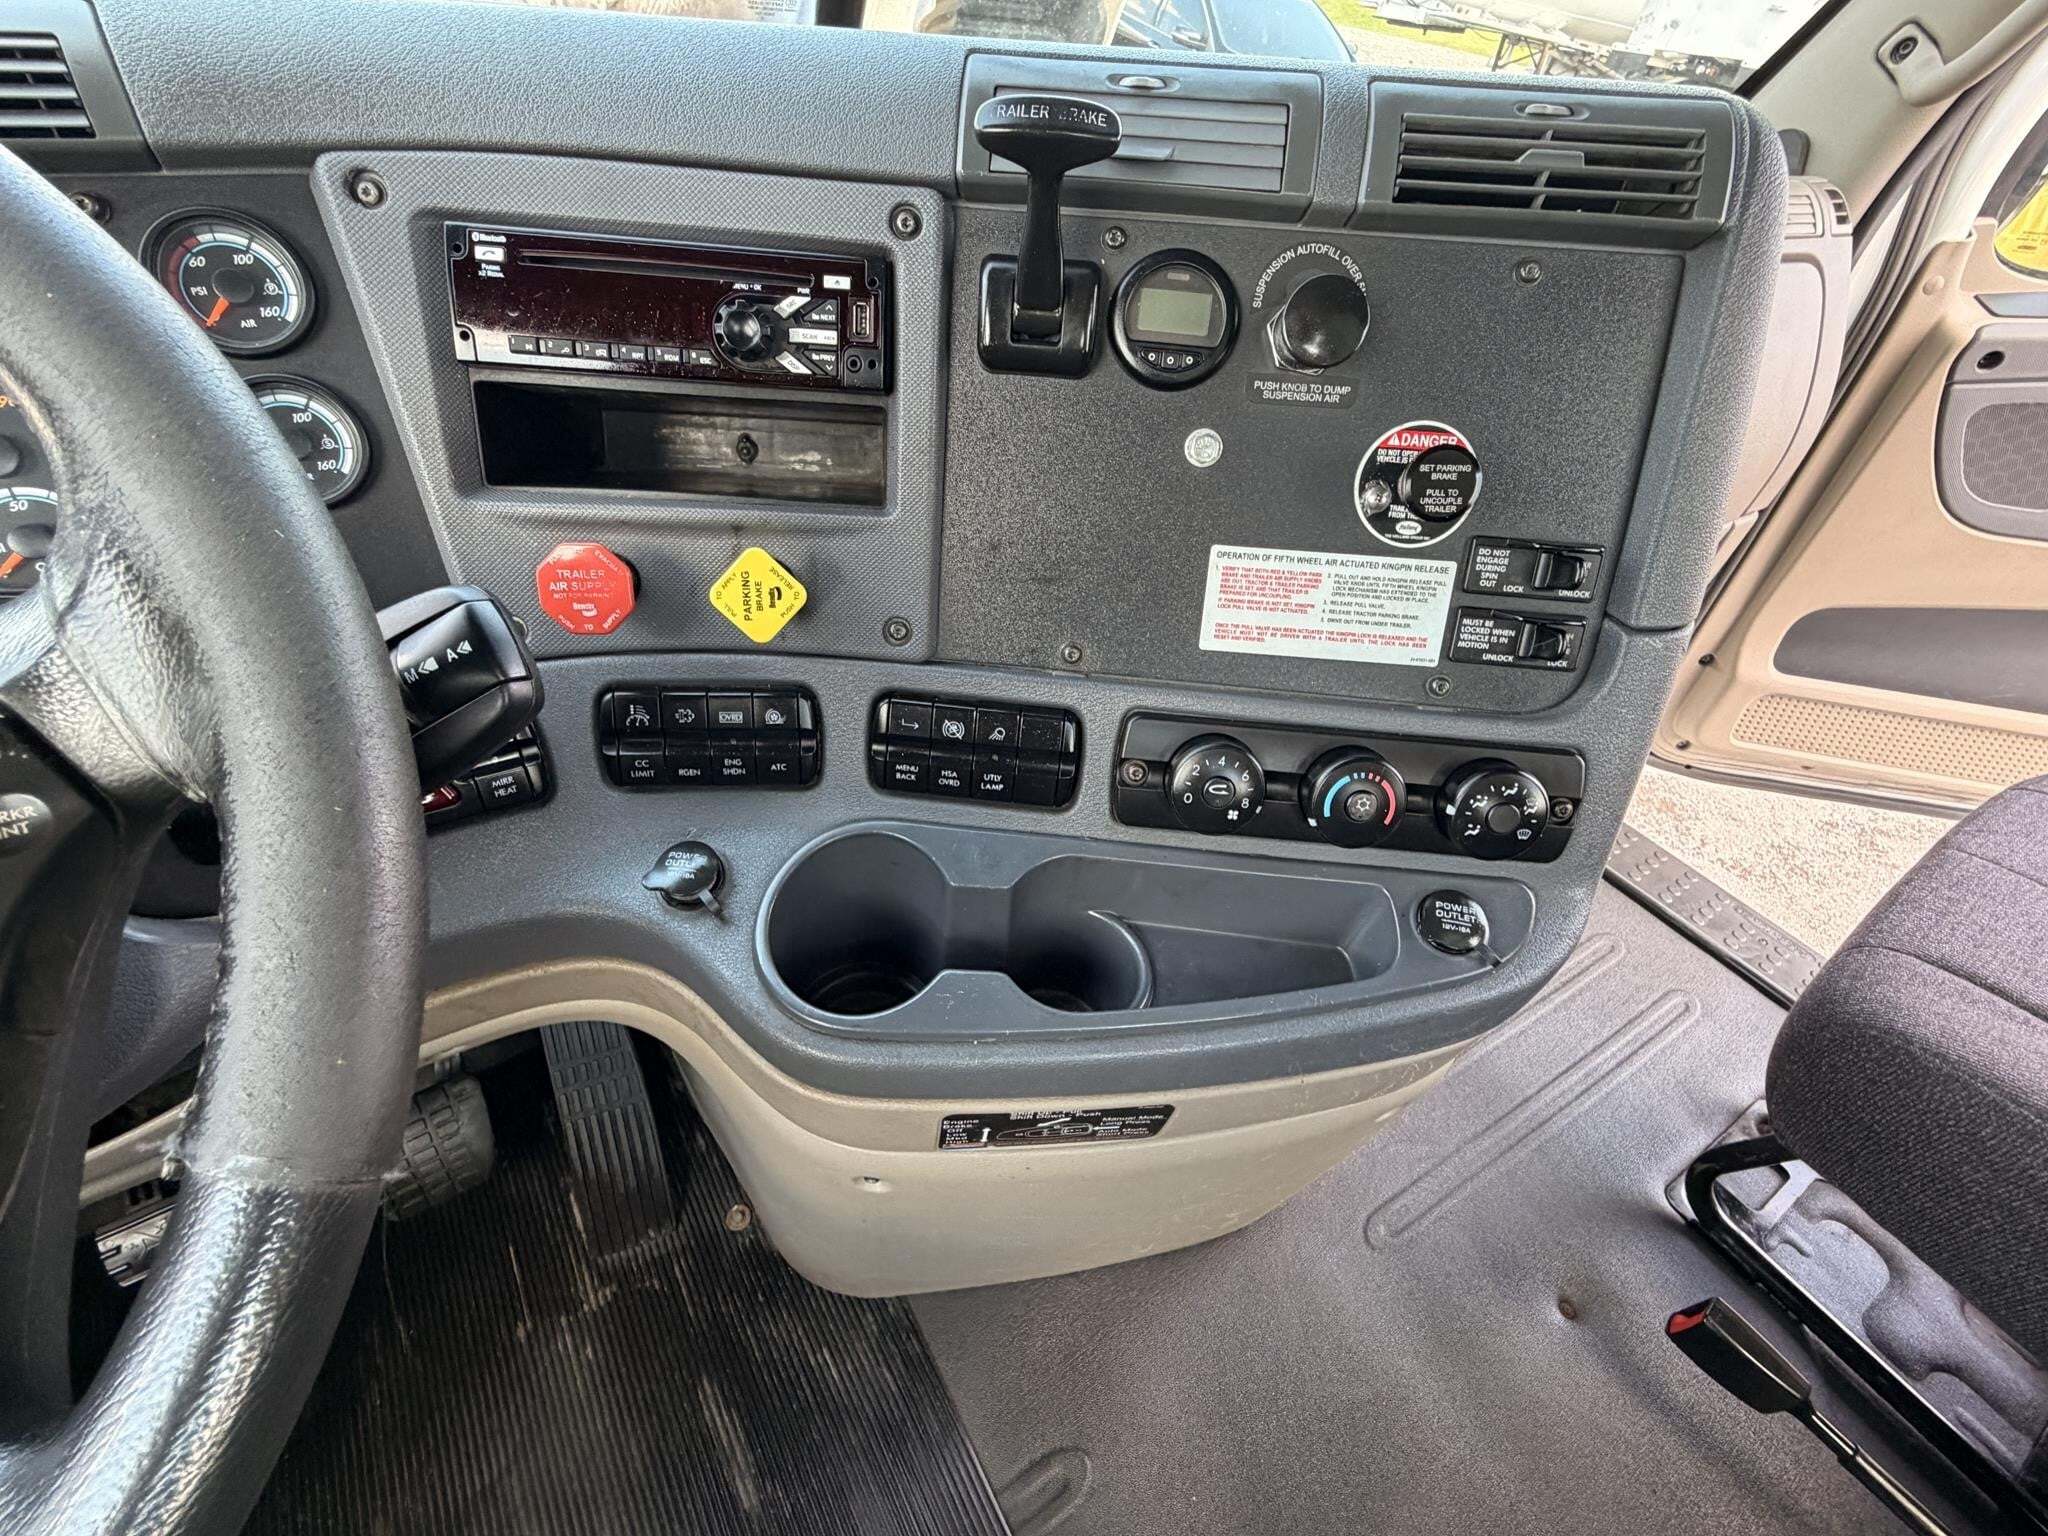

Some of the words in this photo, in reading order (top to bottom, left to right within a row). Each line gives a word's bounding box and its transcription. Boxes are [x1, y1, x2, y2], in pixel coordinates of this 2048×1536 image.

[990, 104, 1050, 119] RAILER
[189, 256, 205, 267] 60
[233, 254, 254, 265] 100
[1253, 248, 1296, 308] SUSPENSION
[1297, 243, 1341, 260] AUTOFILL
[190, 287, 208, 296] PSI
[260, 306, 280, 318] 160
[241, 319, 258, 328] AIR
[820, 354, 835, 362] PREV
[1254, 380, 1279, 390] PUSH
[1282, 382, 1307, 392] KNOB
[1310, 384, 1321, 393] TO
[1324, 385, 1351, 395] DUMP
[1262, 390, 1322, 402] SUSPENSION
[1324, 394, 1340, 403] AIR
[292, 413, 312, 423] 100
[1401, 433, 1458, 448] DANGER
[317, 460, 336, 470] 160
[1420, 464, 1435, 472] SET
[1437, 464, 1472, 472] PARKING
[9, 500, 28, 512] 50
[1420, 497, 1463, 505] UNCOUPLE
[1424, 505, 1457, 513] TRAILER
[1479, 548, 1491, 556] DO
[1217, 551, 1259, 560] OPERATION
[1274, 555, 1295, 563] FIFTH
[1297, 557, 1323, 565] WHEEL
[1340, 560, 1379, 570] ACTUATED
[1381, 563, 1412, 571] KINGPIN
[1414, 565, 1450, 574] RELEASE
[1476, 556, 1509, 565] ENGAGE
[1476, 564, 1506, 573] DURING
[557, 569, 604, 579] TRAILER
[1481, 572, 1498, 580] SPIN
[549, 581, 568, 591] AIR
[741, 571, 752, 621] PARKING
[755, 581, 763, 611] BRAKE
[794, 591, 800, 600] TO
[1503, 585, 1525, 593] LOCK
[1559, 590, 1591, 598] UNLOCK
[1462, 618, 1483, 627] MUST
[1461, 626, 1490, 635] LOCKED
[1492, 629, 1516, 637] WHEN
[1460, 634, 1489, 642] VEHICLE
[1457, 641, 1489, 649] MOTION
[446, 648, 458, 662] A
[1482, 653, 1514, 662] UNLOCK
[404, 668, 419, 684] M
[635, 760, 649, 768] CC
[1218, 756, 1226, 766] 4
[895, 764, 919, 773] MENU
[1192, 764, 1200, 776] 2
[631, 770, 655, 778] LIMIT
[896, 773, 916, 781] BACK
[984, 774, 1002, 782] UTLY
[1241, 770, 1249, 781] 6
[492, 776, 514, 787] MIRR
[938, 778, 960, 787] OVRD
[981, 782, 1003, 791] LAMP
[494, 786, 517, 798] HEAT
[1184, 792, 1193, 803] 0
[1241, 798, 1249, 808] 8
[0, 806, 38, 823] RKR
[1436, 901, 1476, 915] POWER
[1436, 909, 1476, 924] OUTLET
